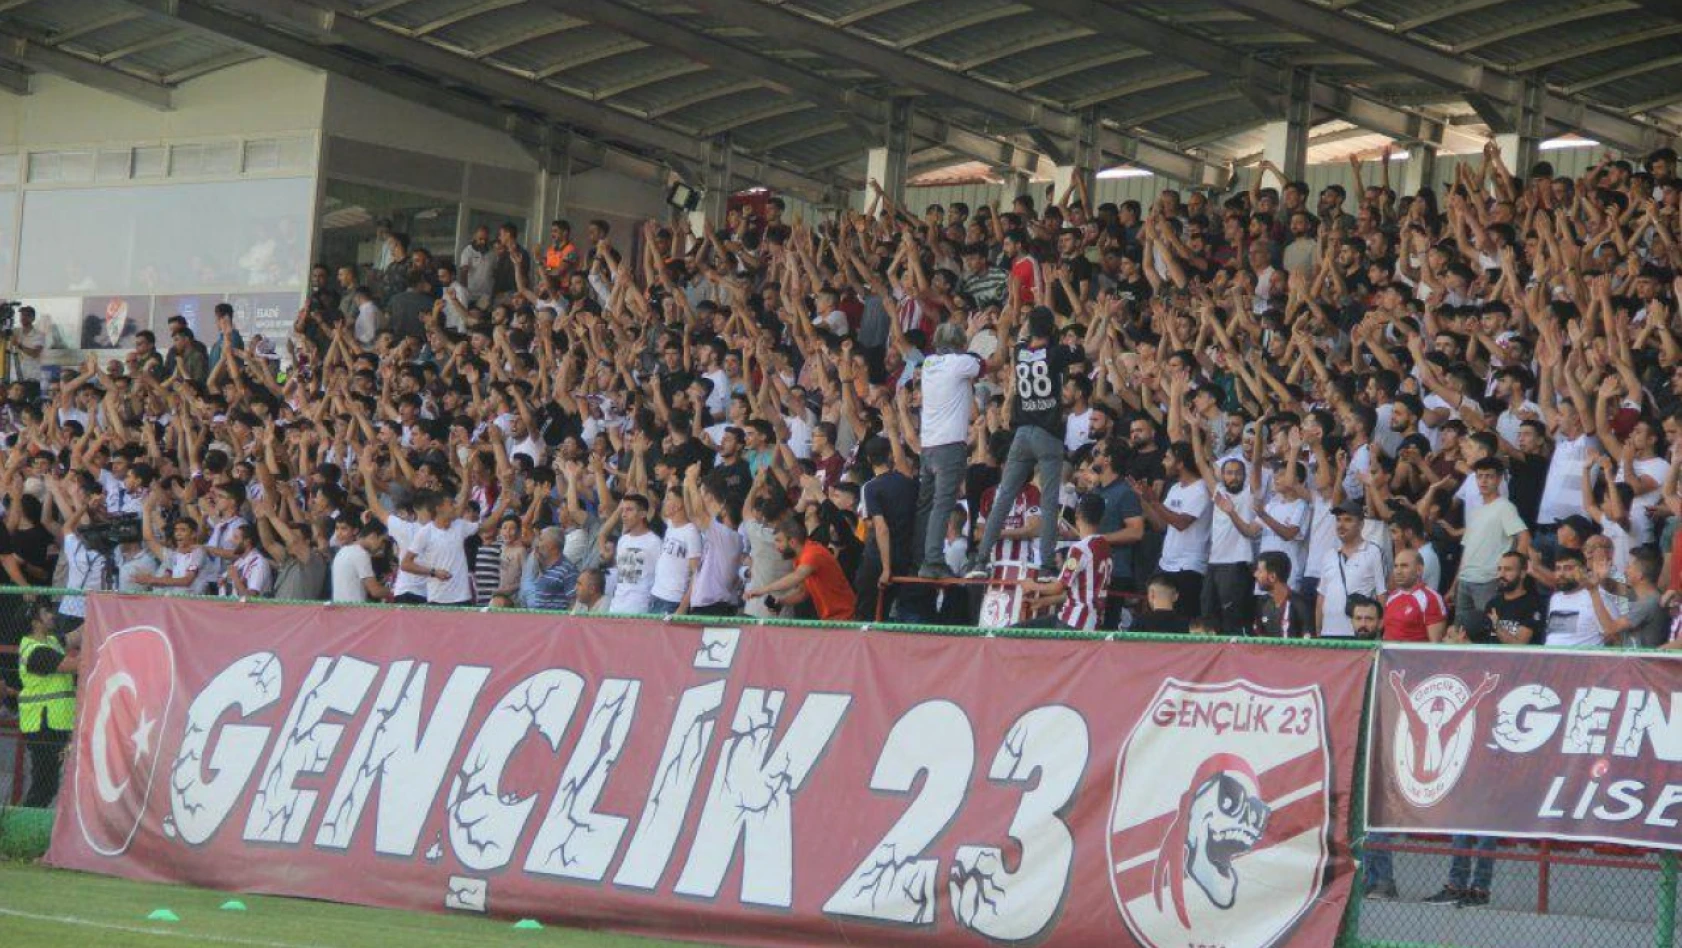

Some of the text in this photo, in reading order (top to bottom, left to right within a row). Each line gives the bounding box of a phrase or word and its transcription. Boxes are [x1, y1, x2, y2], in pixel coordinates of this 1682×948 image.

[1016, 361, 1051, 399] 88
[1152, 696, 1314, 735] GENÇLİK 23
[170, 628, 1090, 942] GENÇLİK 23
